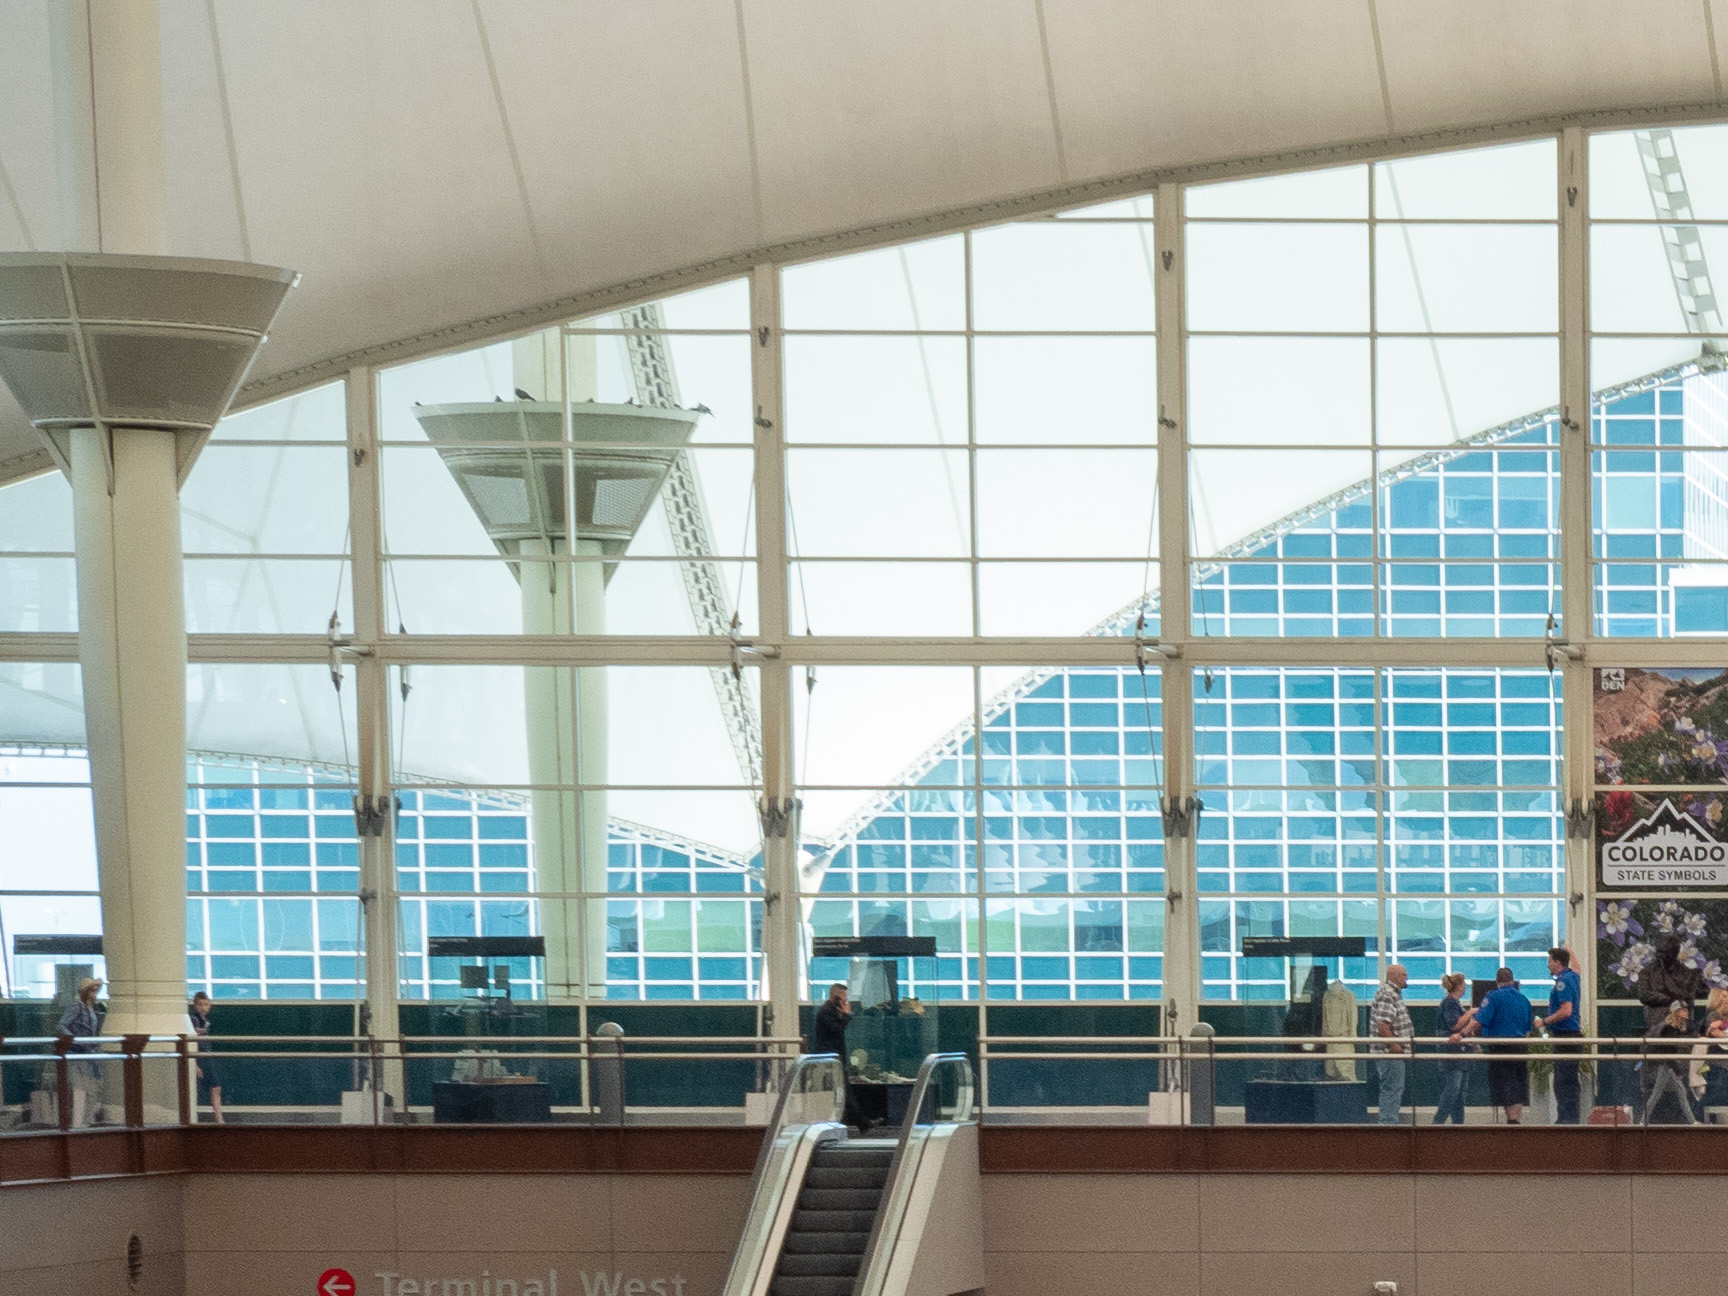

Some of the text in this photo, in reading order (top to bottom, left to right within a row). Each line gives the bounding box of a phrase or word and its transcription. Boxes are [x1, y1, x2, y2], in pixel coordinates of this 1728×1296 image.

[1601, 682, 1624, 691] DEN
[1608, 846, 1725, 863] COLORADO
[1617, 869, 1716, 881] STATE SYMBOLS
